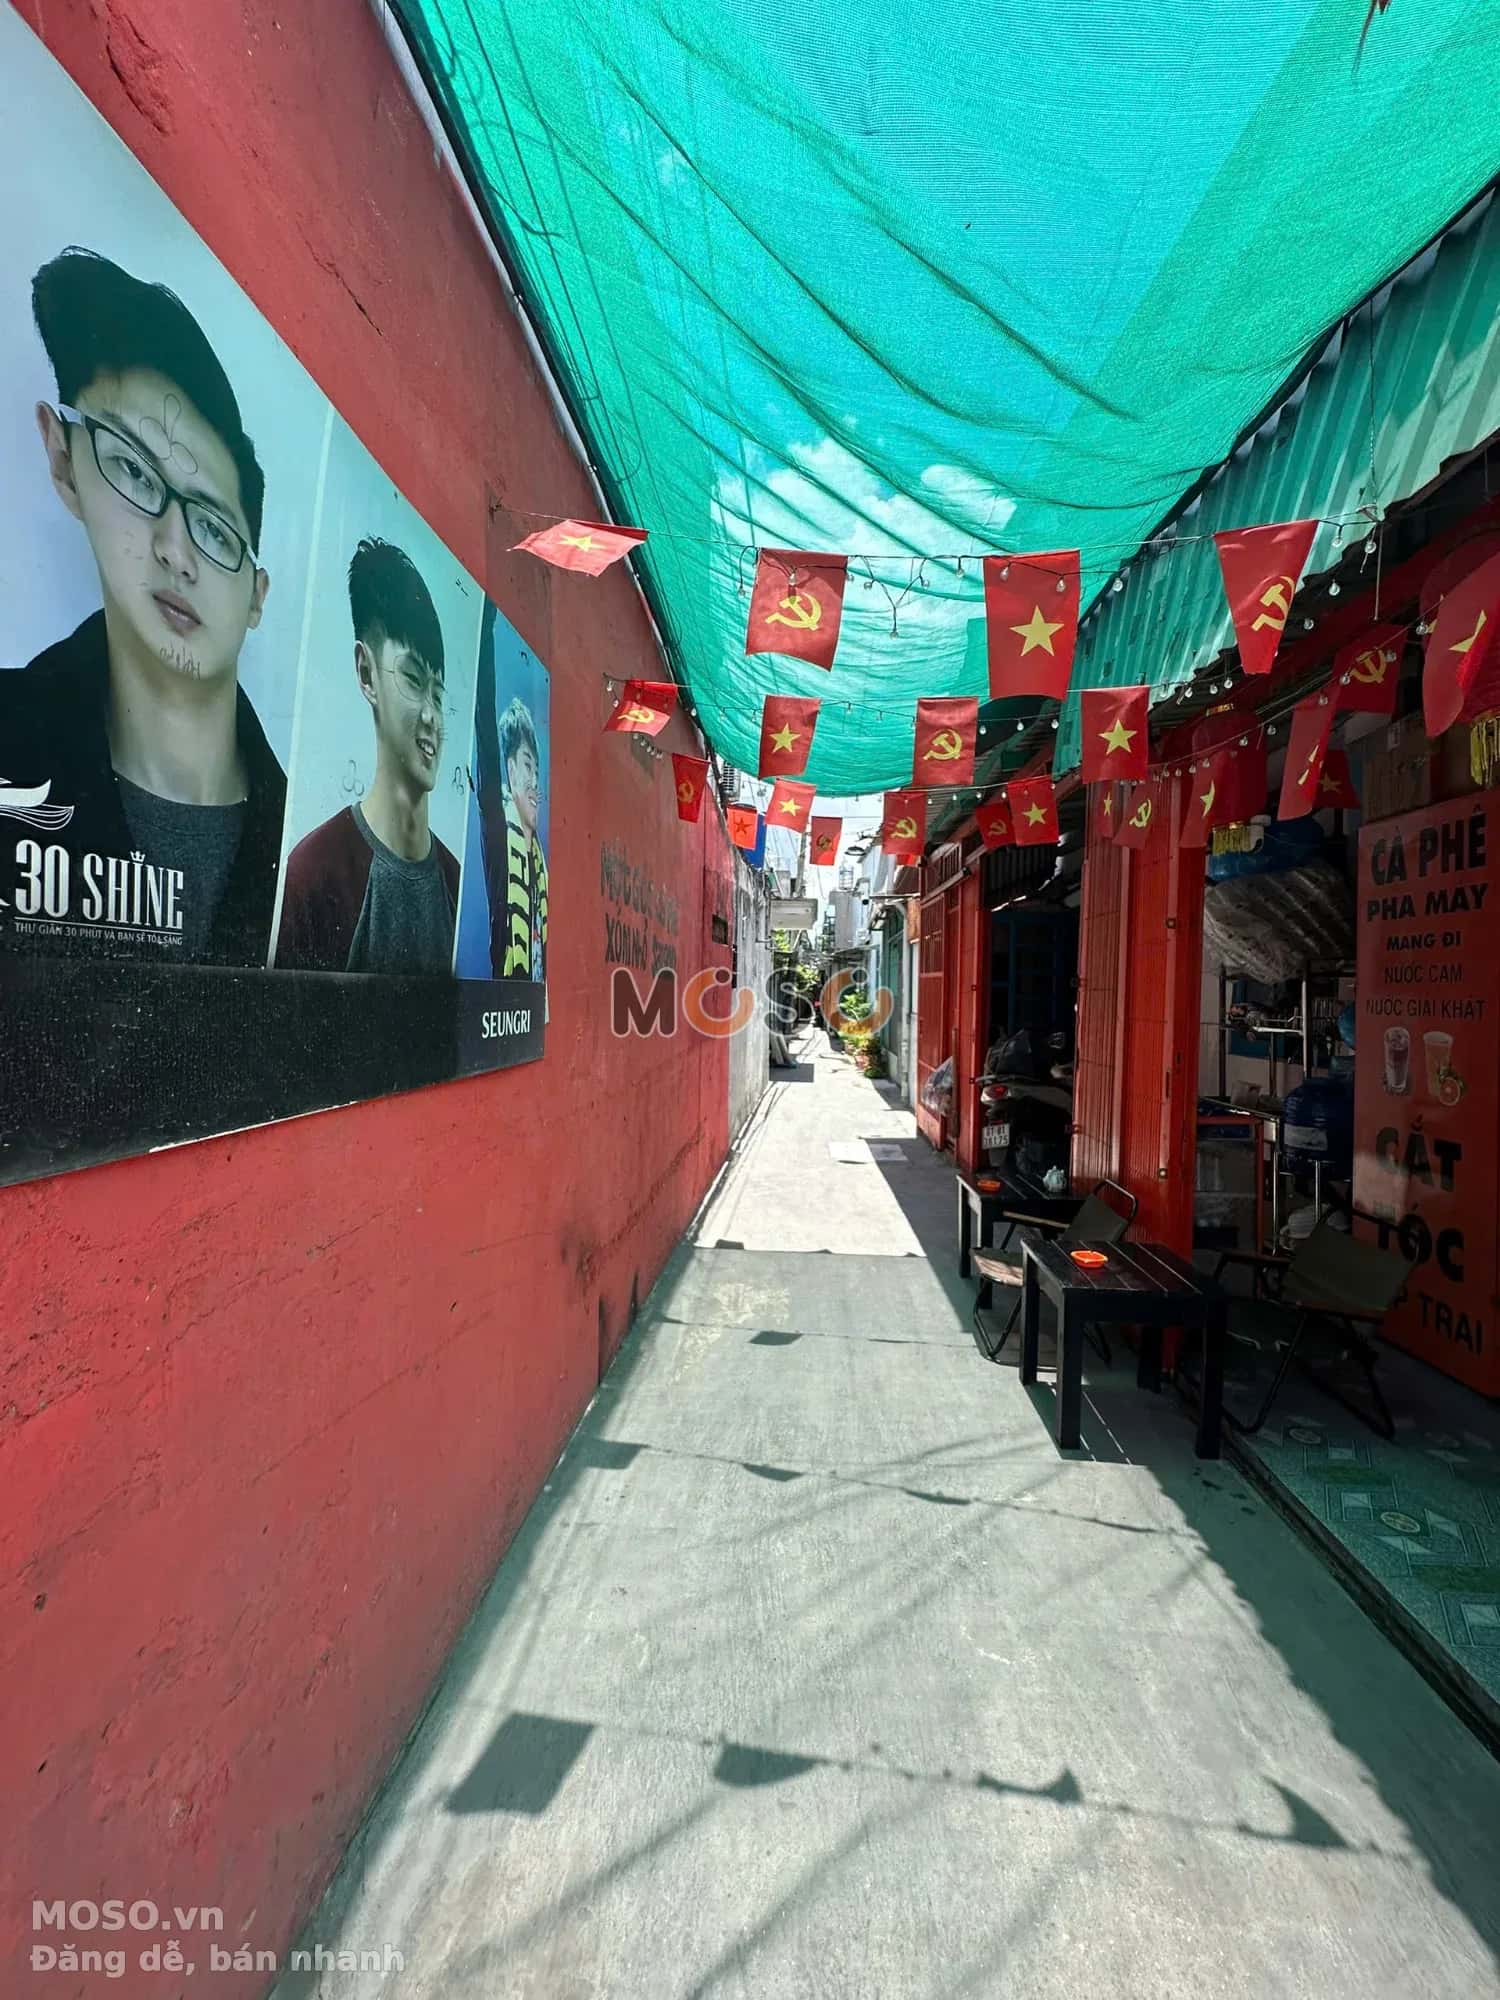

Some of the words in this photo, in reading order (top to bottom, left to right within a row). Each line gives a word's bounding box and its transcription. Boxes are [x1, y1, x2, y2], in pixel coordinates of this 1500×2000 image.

[1418, 804, 1487, 878] PHÊ
[15, 839, 70, 918] 30
[82, 852, 184, 930] SHINE
[1367, 893, 1416, 922] PHA
[65, 926, 77, 937] 30
[1386, 932, 1435, 953] MANG
[1441, 930, 1461, 948] ĐI
[1429, 963, 1463, 984] CAM
[481, 1009, 531, 1039] SEUNGRI
[1418, 1291, 1483, 1355] TRAI
